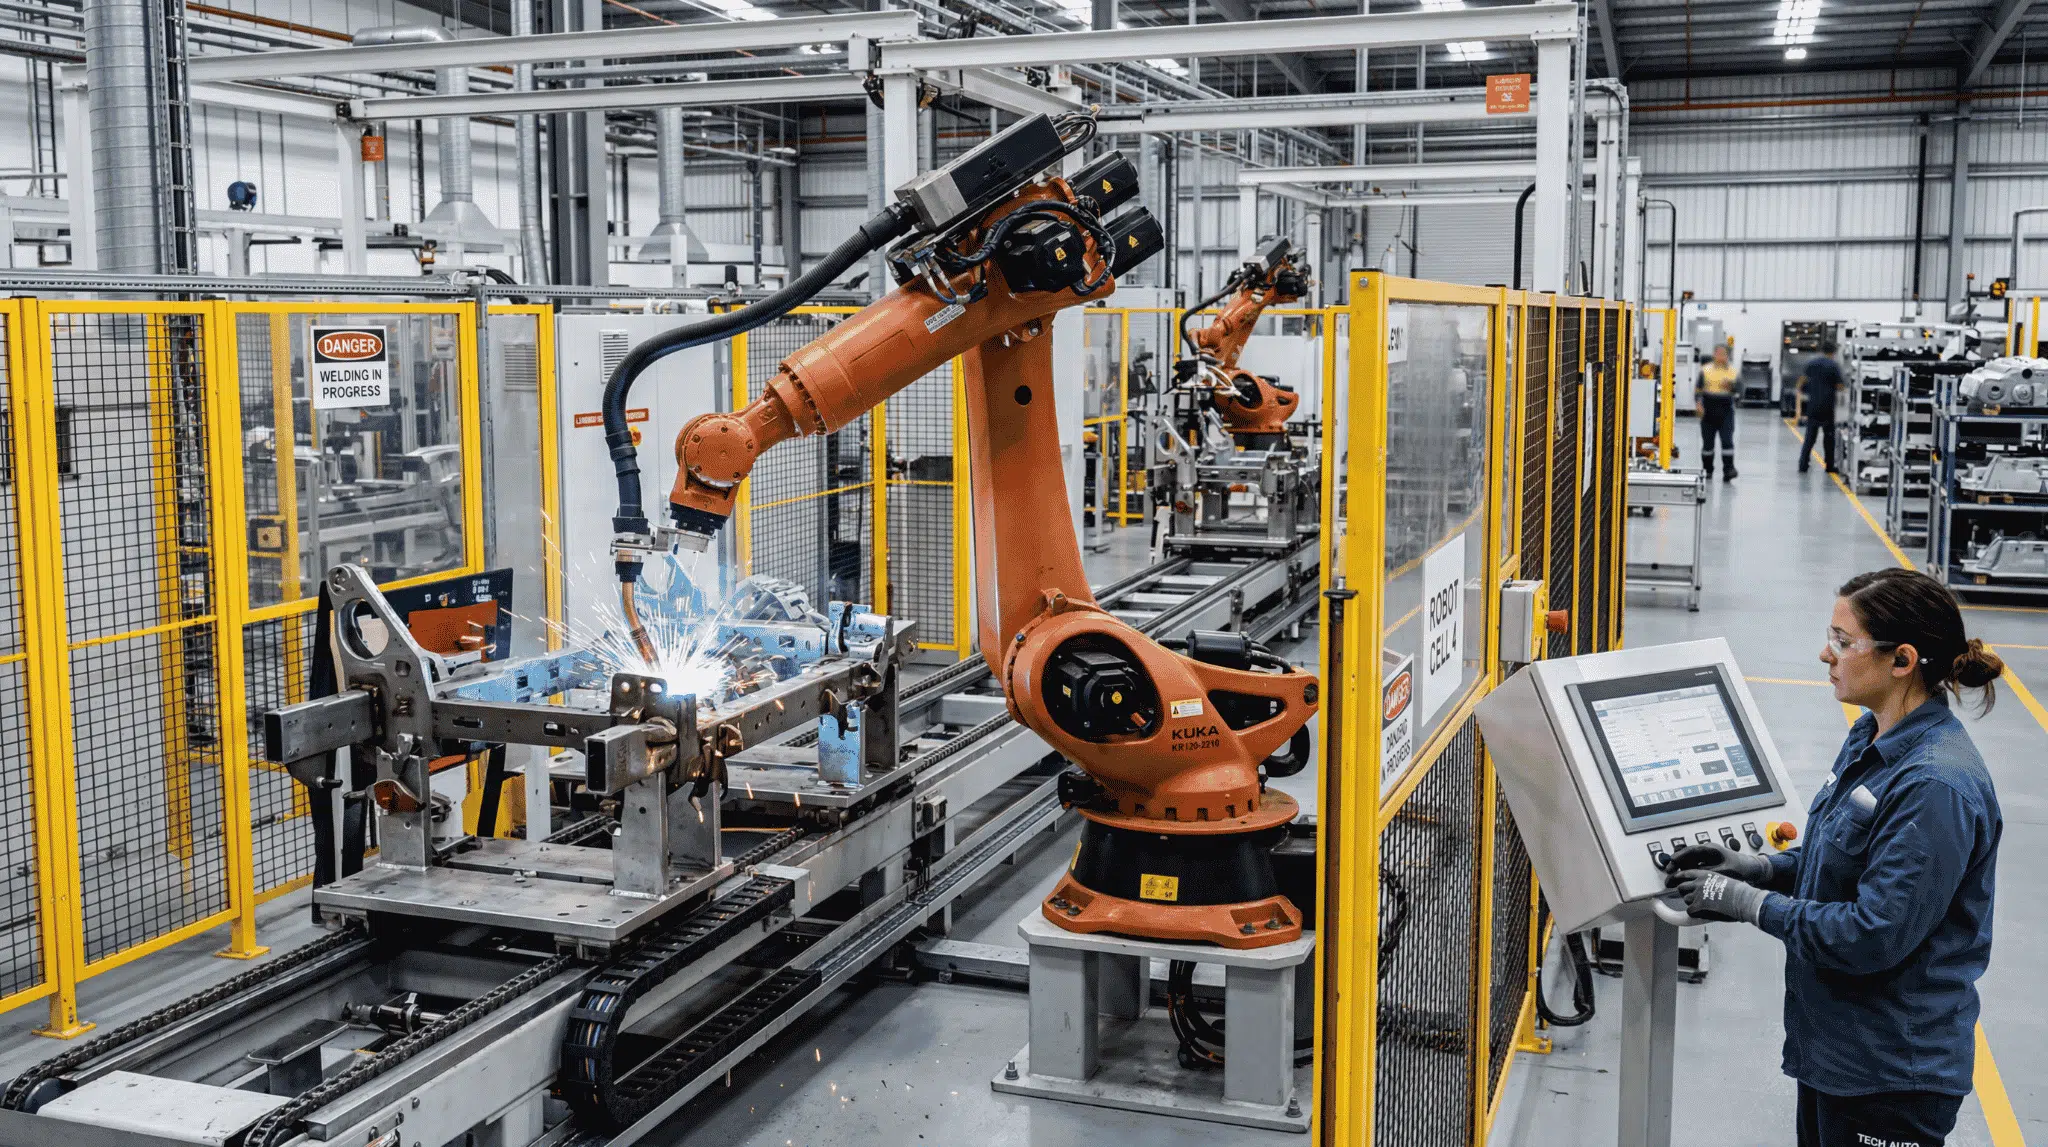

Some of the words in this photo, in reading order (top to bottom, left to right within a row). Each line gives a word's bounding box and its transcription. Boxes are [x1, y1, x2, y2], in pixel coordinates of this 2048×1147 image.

[323, 338, 377, 354] DANGER
[320, 369, 370, 383] WELDING
[372, 369, 382, 381] IN
[322, 385, 381, 399] PROGRESS
[1430, 578, 1459, 632] ROBOT
[1430, 630, 1450, 676] CELL
[1452, 621, 1457, 652] 4
[1171, 725, 1219, 740] KUKA
[1857, 1133, 1886, 1147] TECH
